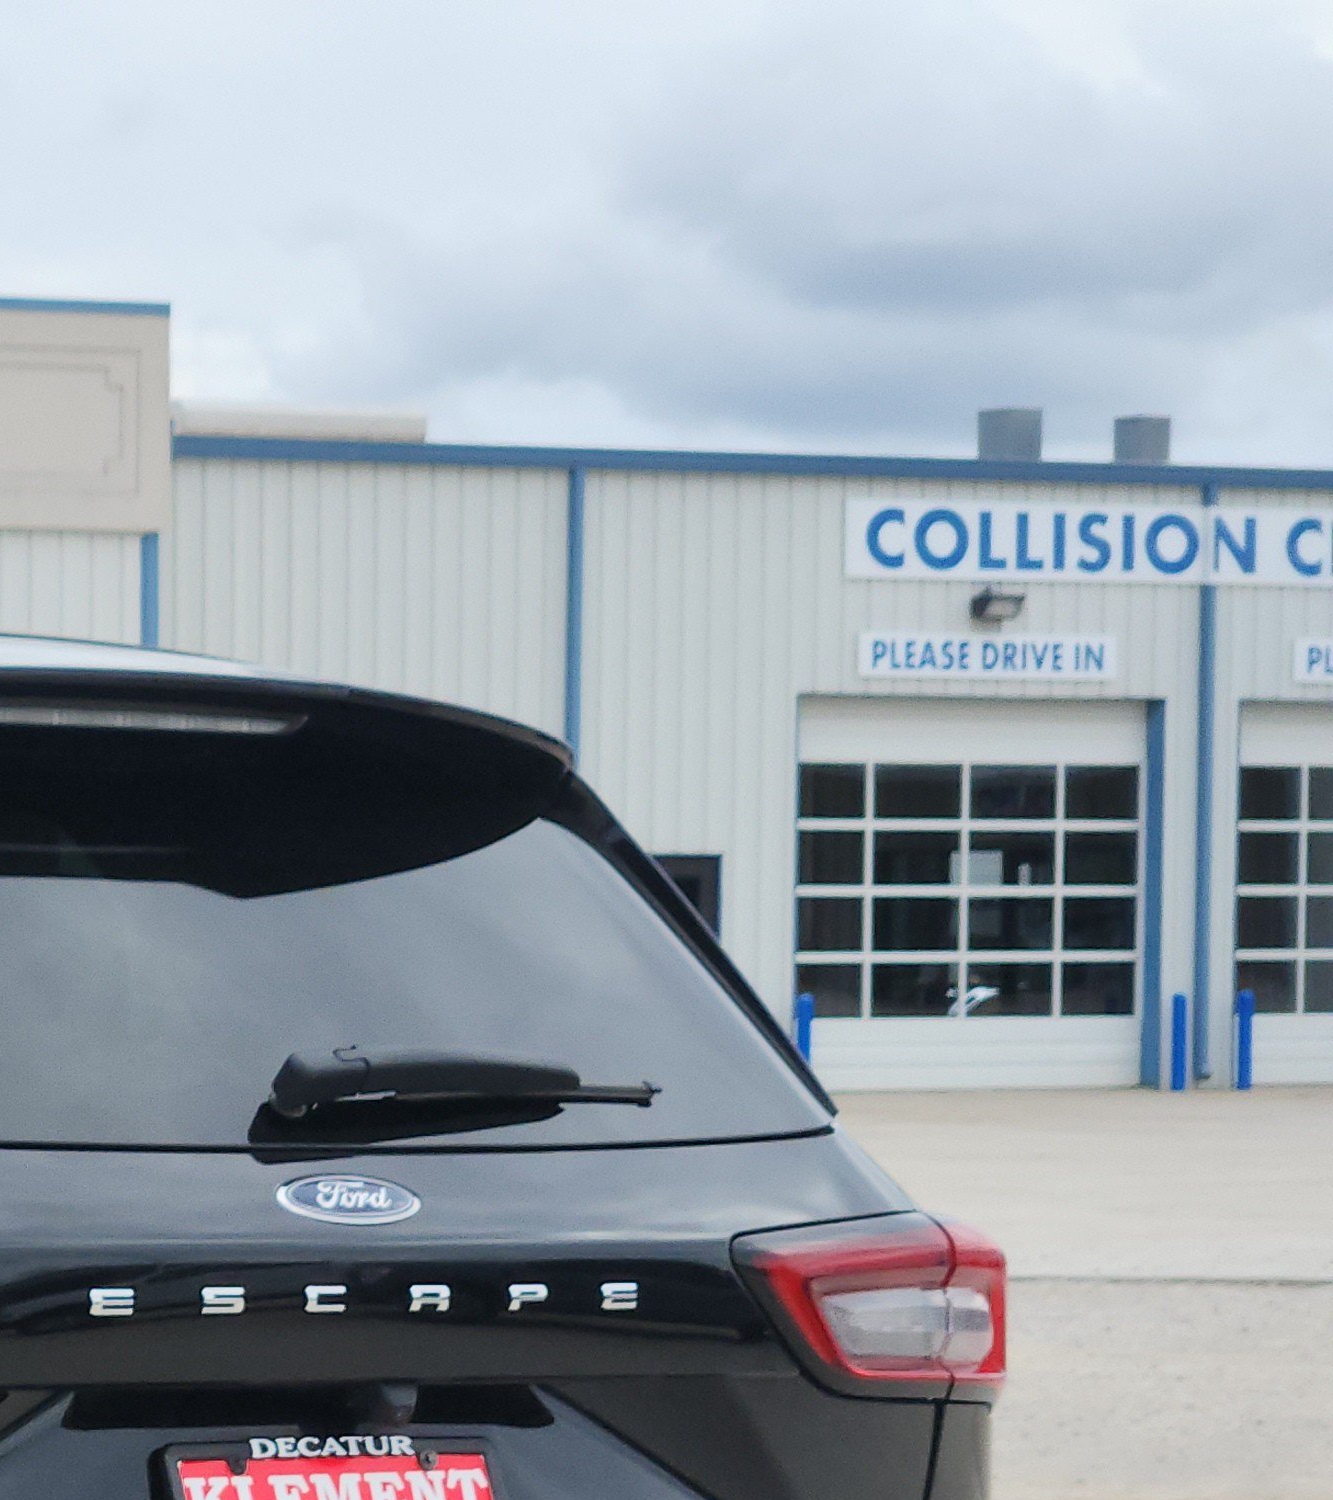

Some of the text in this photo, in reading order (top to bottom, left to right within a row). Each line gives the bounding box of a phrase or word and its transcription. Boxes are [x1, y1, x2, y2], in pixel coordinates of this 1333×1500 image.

[866, 508, 1333, 576] COLLISION C
[872, 640, 1106, 672] PLEASE DRIVE IN
[315, 1178, 393, 1211] Ford
[89, 1282, 638, 1317] ESCAPE
[249, 1435, 415, 1459] DECATUR
